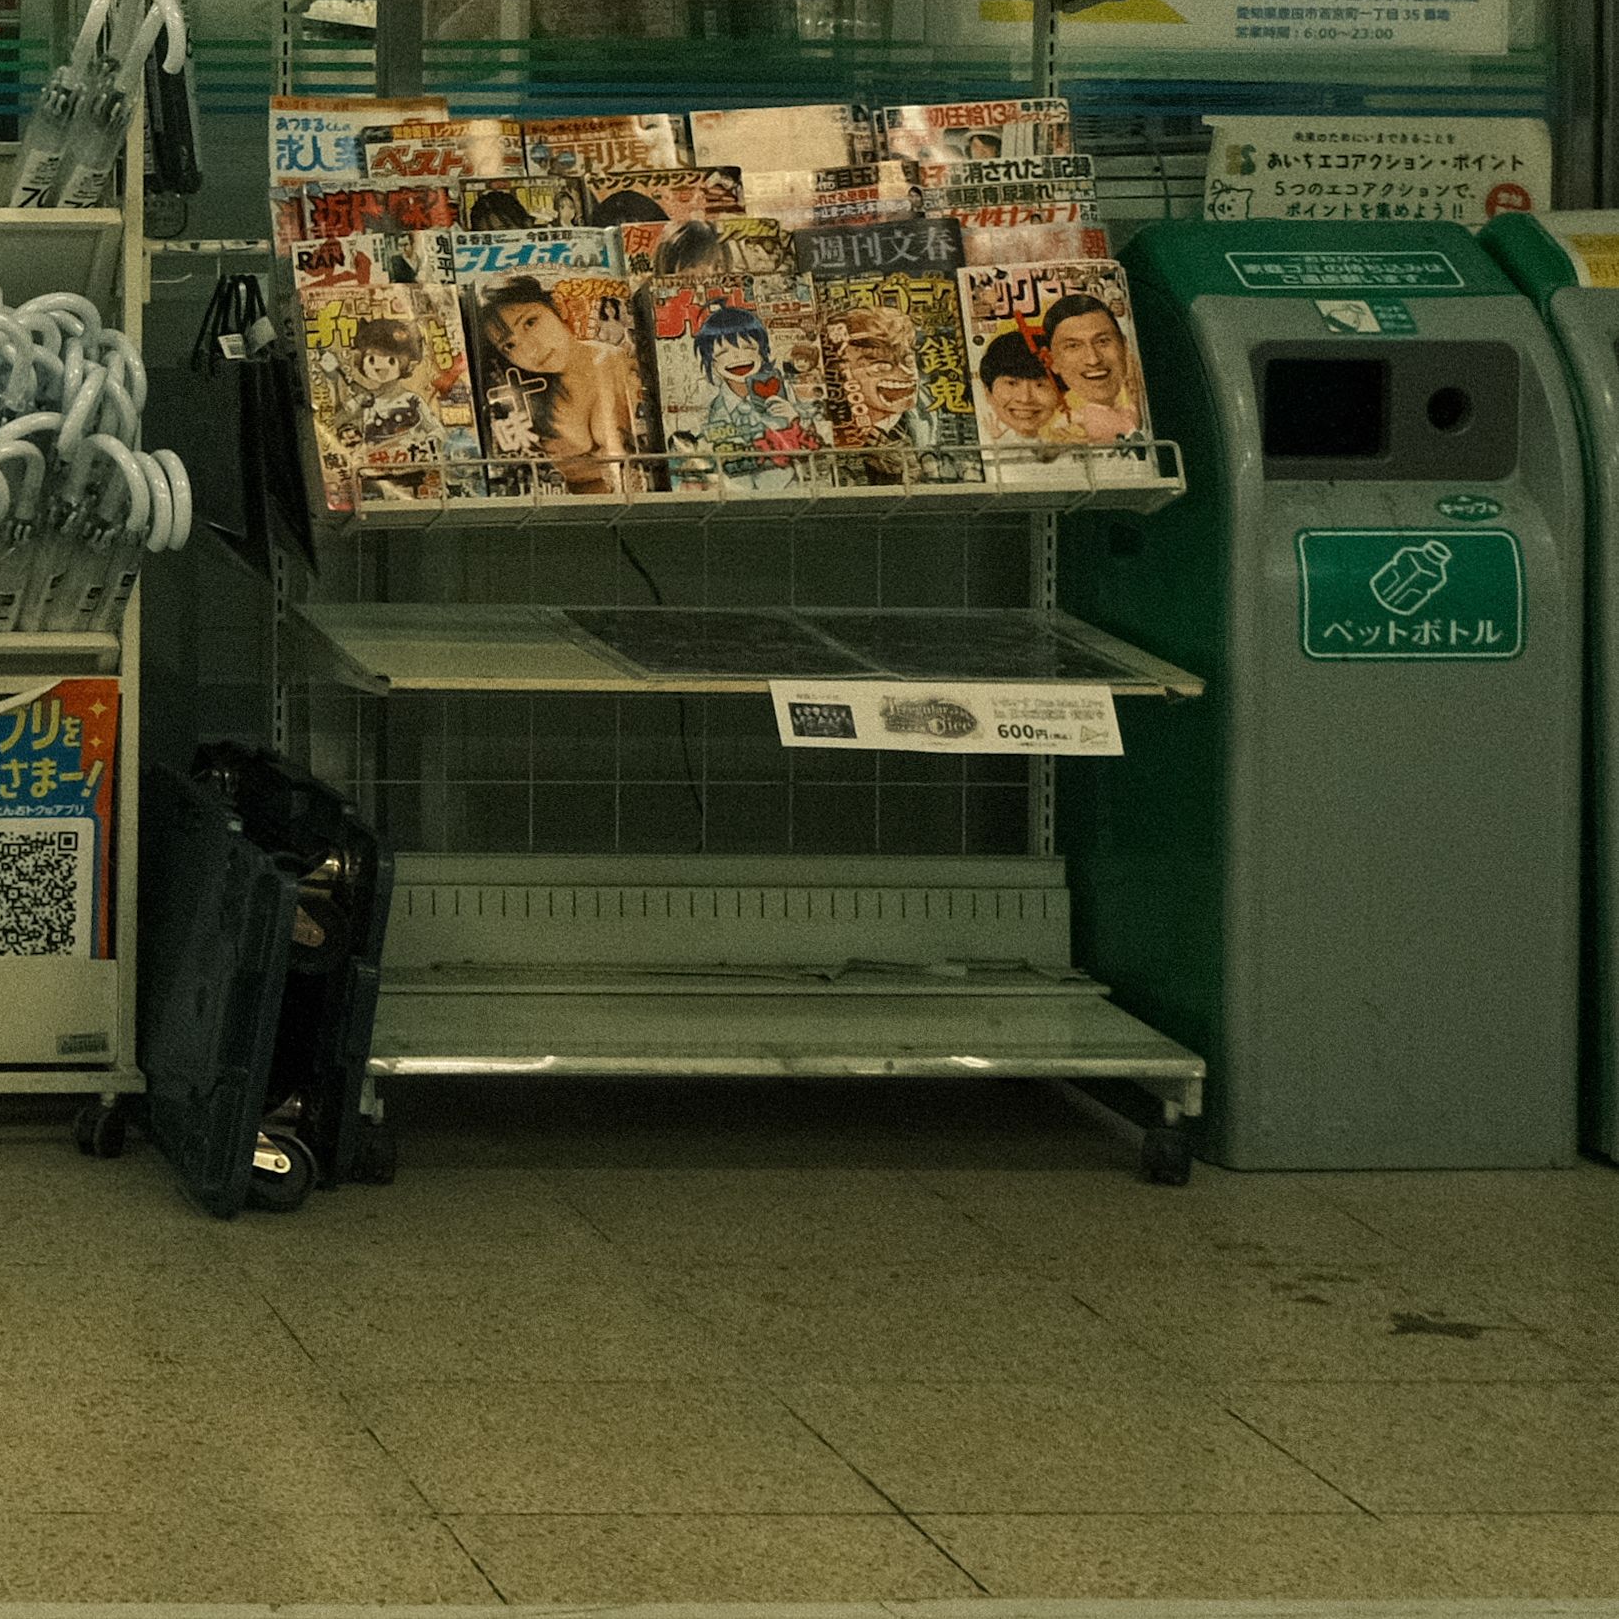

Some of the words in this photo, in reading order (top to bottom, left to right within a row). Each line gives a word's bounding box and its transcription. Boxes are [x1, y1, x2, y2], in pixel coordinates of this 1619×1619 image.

[963, 158, 1043, 183] 消された
[1052, 156, 1090, 179] 記録
[1266, 153, 1525, 173] あいちエコアクション・ポイント
[810, 225, 958, 270] 週刊文春
[1322, 619, 1503, 646] ペットボトル
